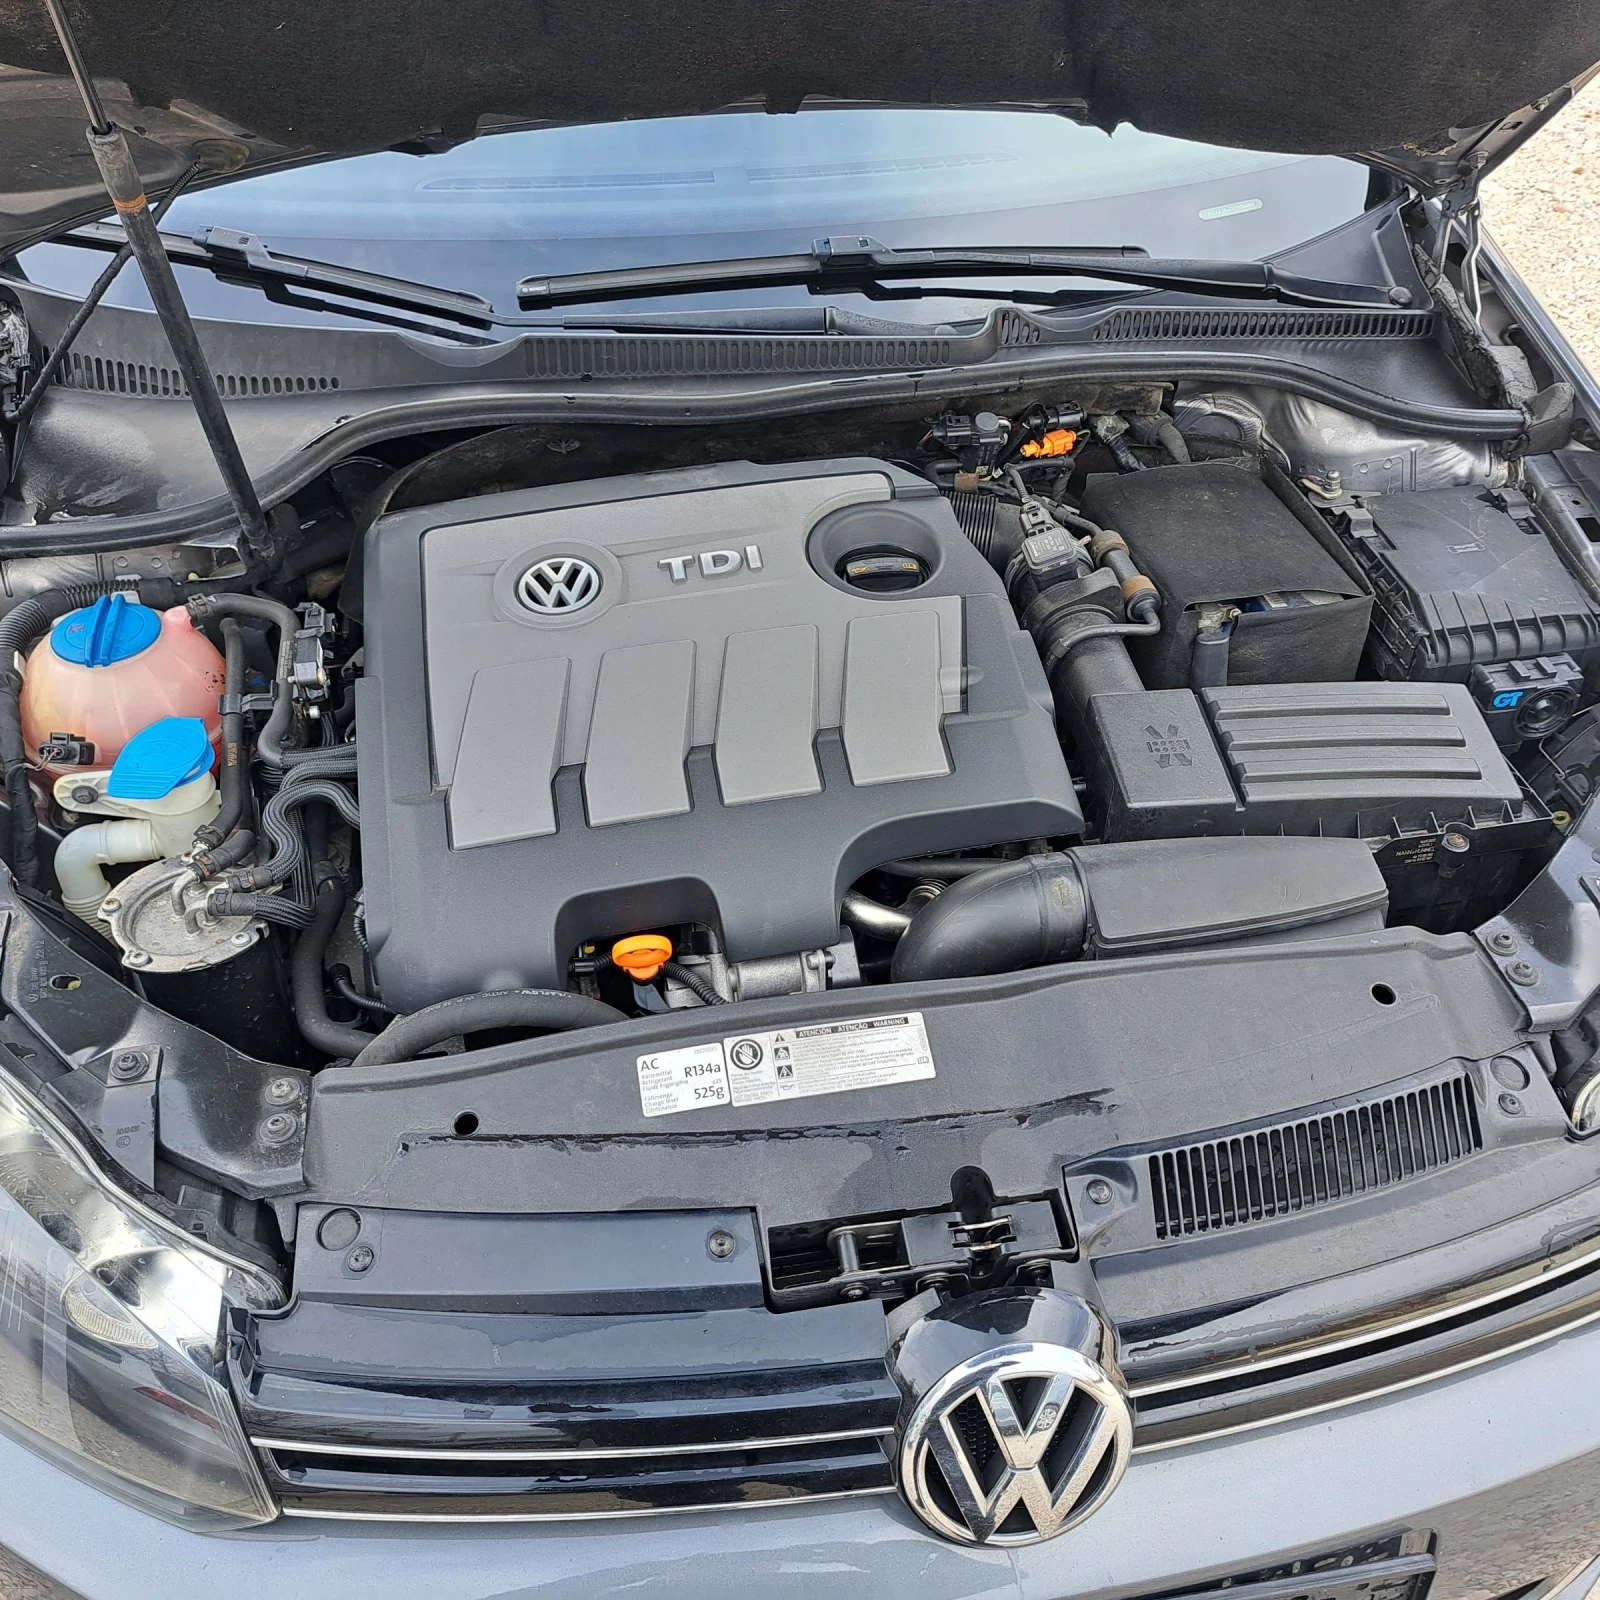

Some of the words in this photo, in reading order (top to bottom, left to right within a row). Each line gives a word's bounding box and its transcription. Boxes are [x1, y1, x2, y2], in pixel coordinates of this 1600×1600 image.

[657, 544, 762, 584] TDI
[1493, 691, 1524, 708] GT
[799, 1027, 832, 1038] ATENCIÓN
[837, 1022, 868, 1033] ATENÇÃO
[872, 1017, 906, 1028] WARNING
[640, 1058, 660, 1072] AC
[684, 1063, 721, 1078] R134a
[694, 1085, 725, 1100] 525g
